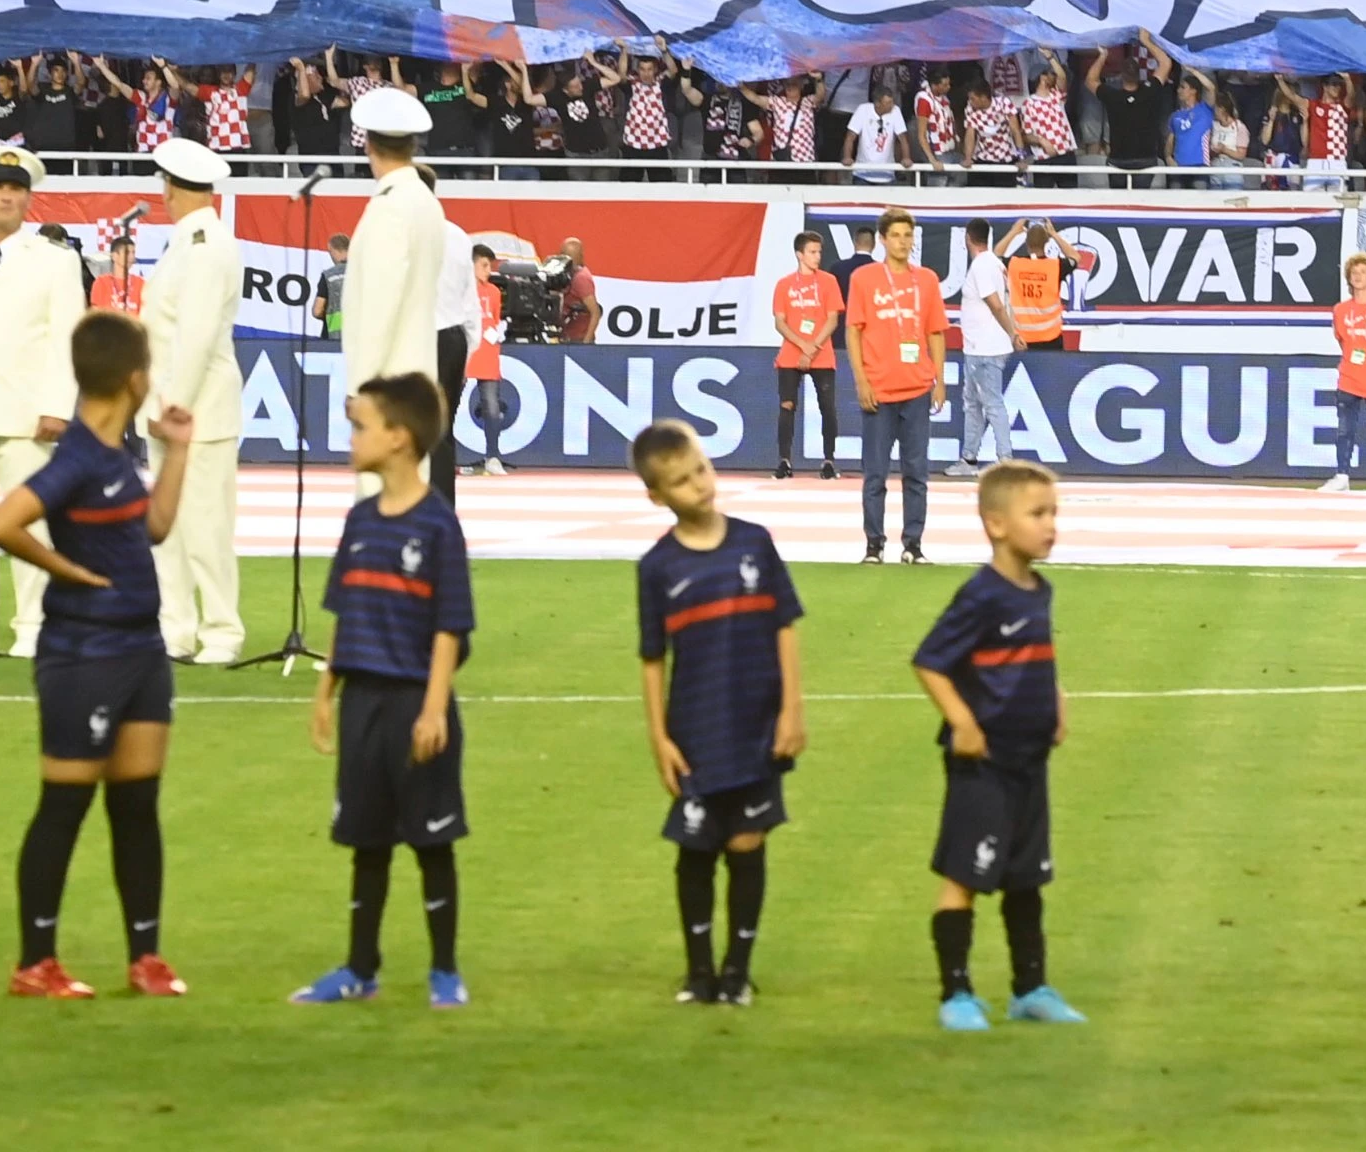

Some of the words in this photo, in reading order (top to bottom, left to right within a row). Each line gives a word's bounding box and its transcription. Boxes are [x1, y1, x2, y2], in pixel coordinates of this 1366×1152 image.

[829, 223, 1317, 303] UOVAR
[598, 302, 738, 338] OLJE
[241, 351, 745, 457] ATONS
